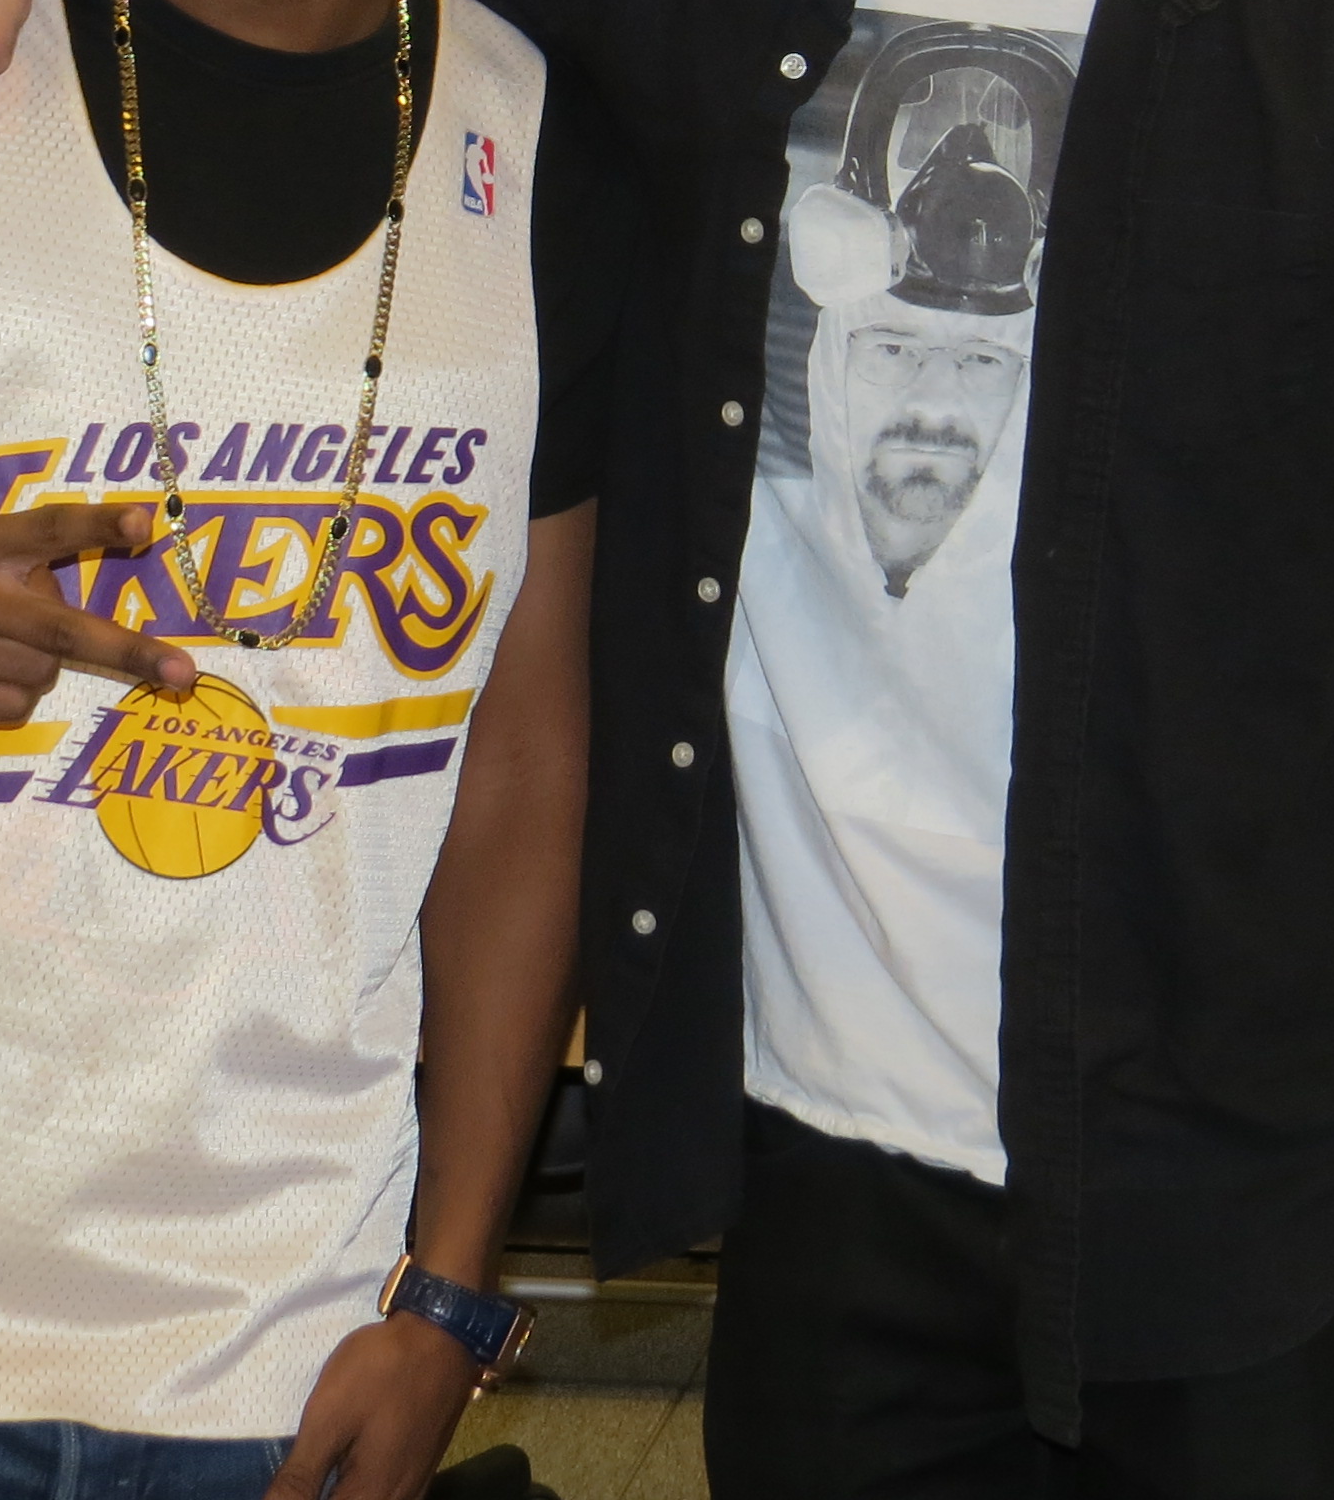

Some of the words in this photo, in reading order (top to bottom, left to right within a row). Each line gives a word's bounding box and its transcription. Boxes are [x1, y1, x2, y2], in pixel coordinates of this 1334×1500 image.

[464, 194, 484, 212] NBA
[66, 422, 200, 484] LOS
[199, 424, 488, 485] ANGELES
[143, 715, 200, 737] LOS
[201, 724, 341, 762] ANGELES
[32, 706, 337, 846] LAKERS
